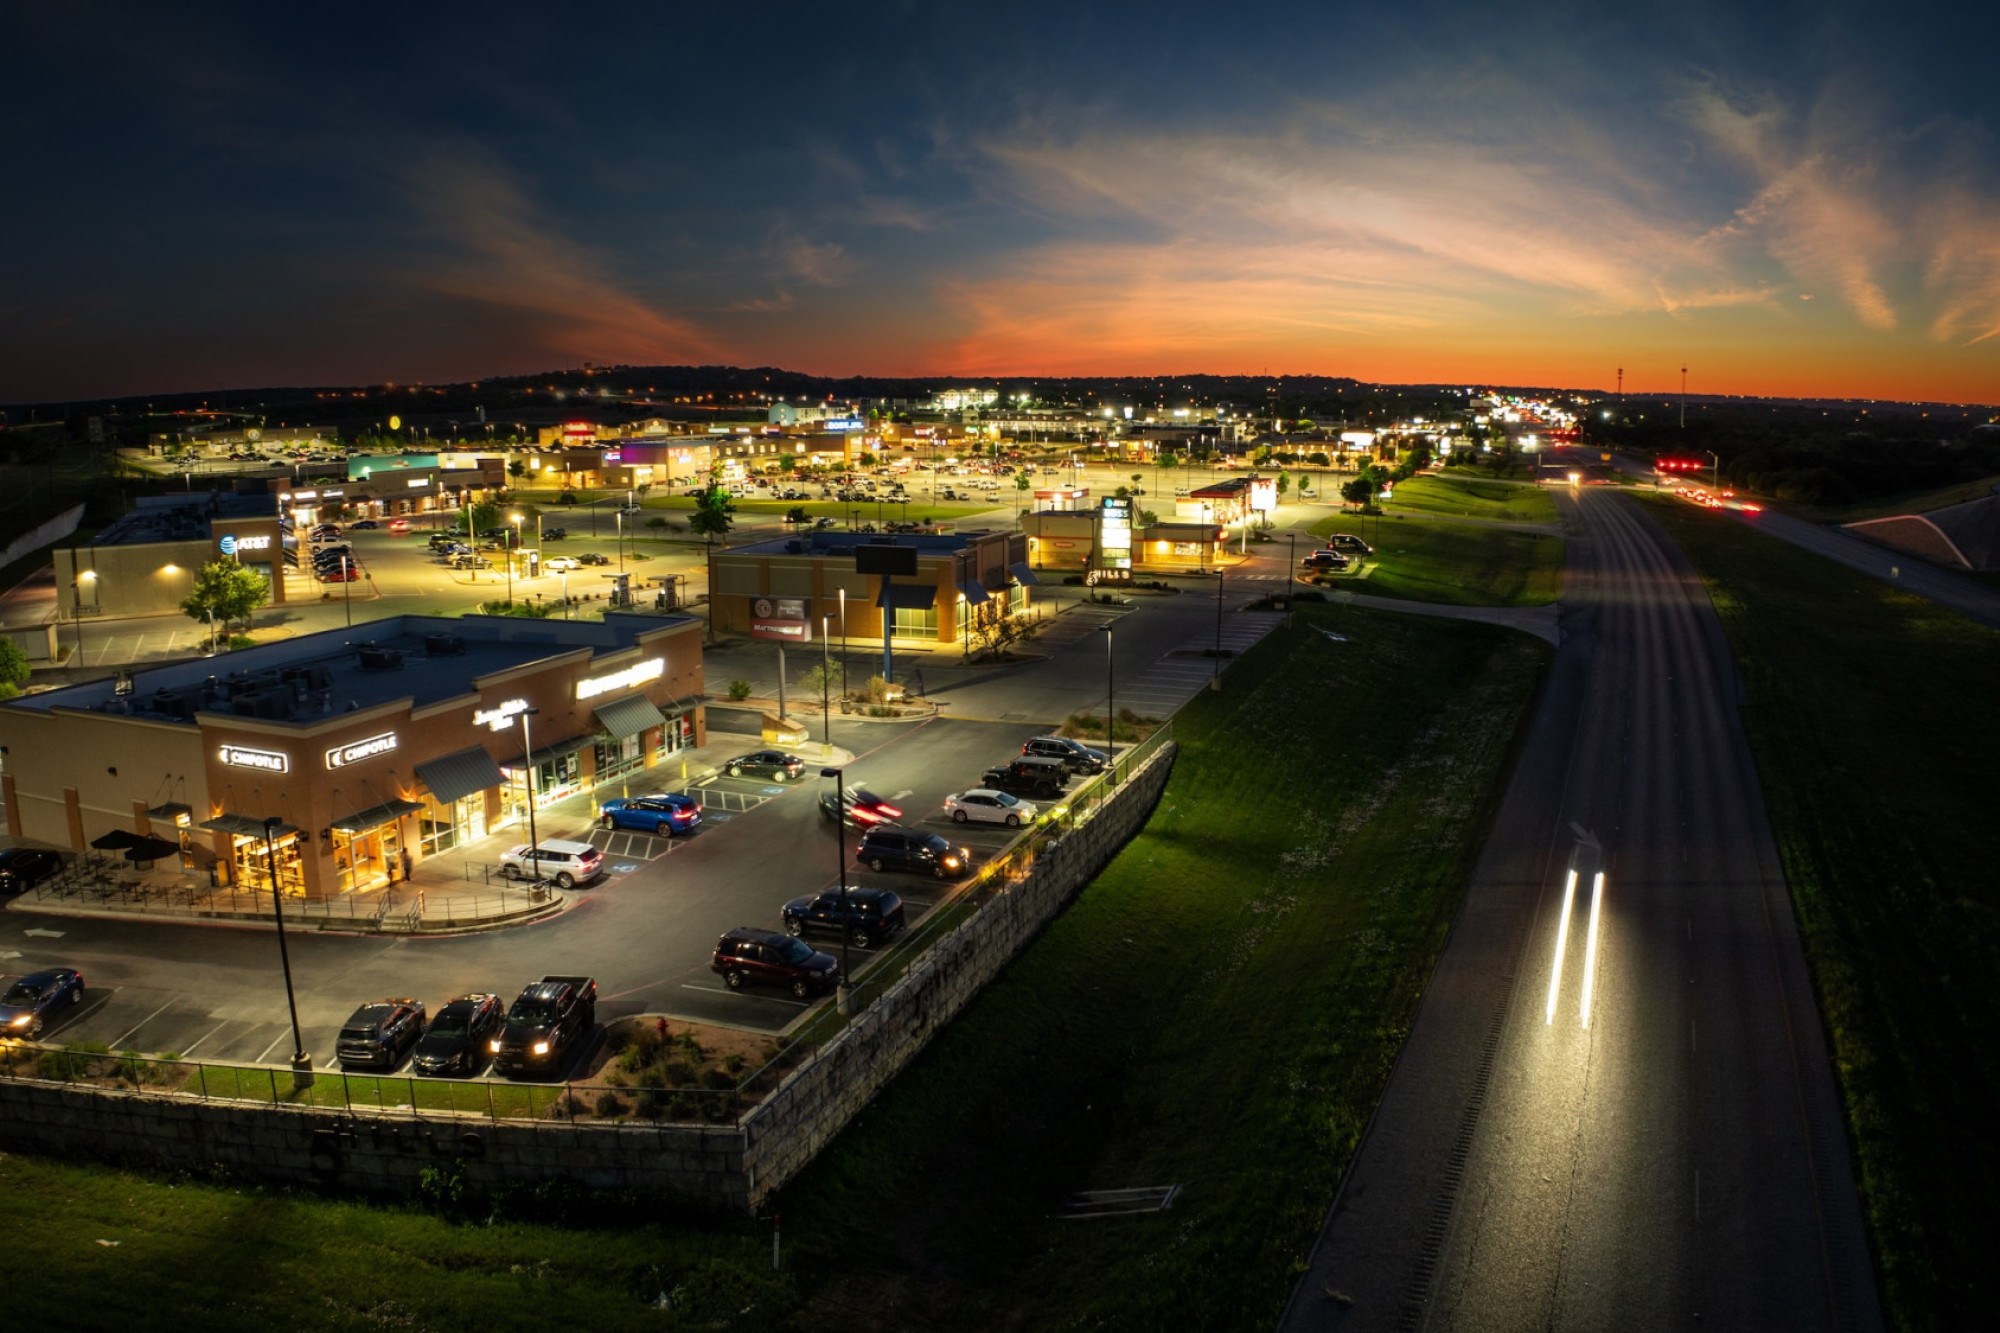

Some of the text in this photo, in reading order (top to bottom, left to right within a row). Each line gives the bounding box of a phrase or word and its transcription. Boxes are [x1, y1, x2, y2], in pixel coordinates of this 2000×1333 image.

[237, 535, 270, 550] AT&T
[345, 736, 398, 761] CHIPOTLE
[231, 751, 282, 770] CHIPOTLE
